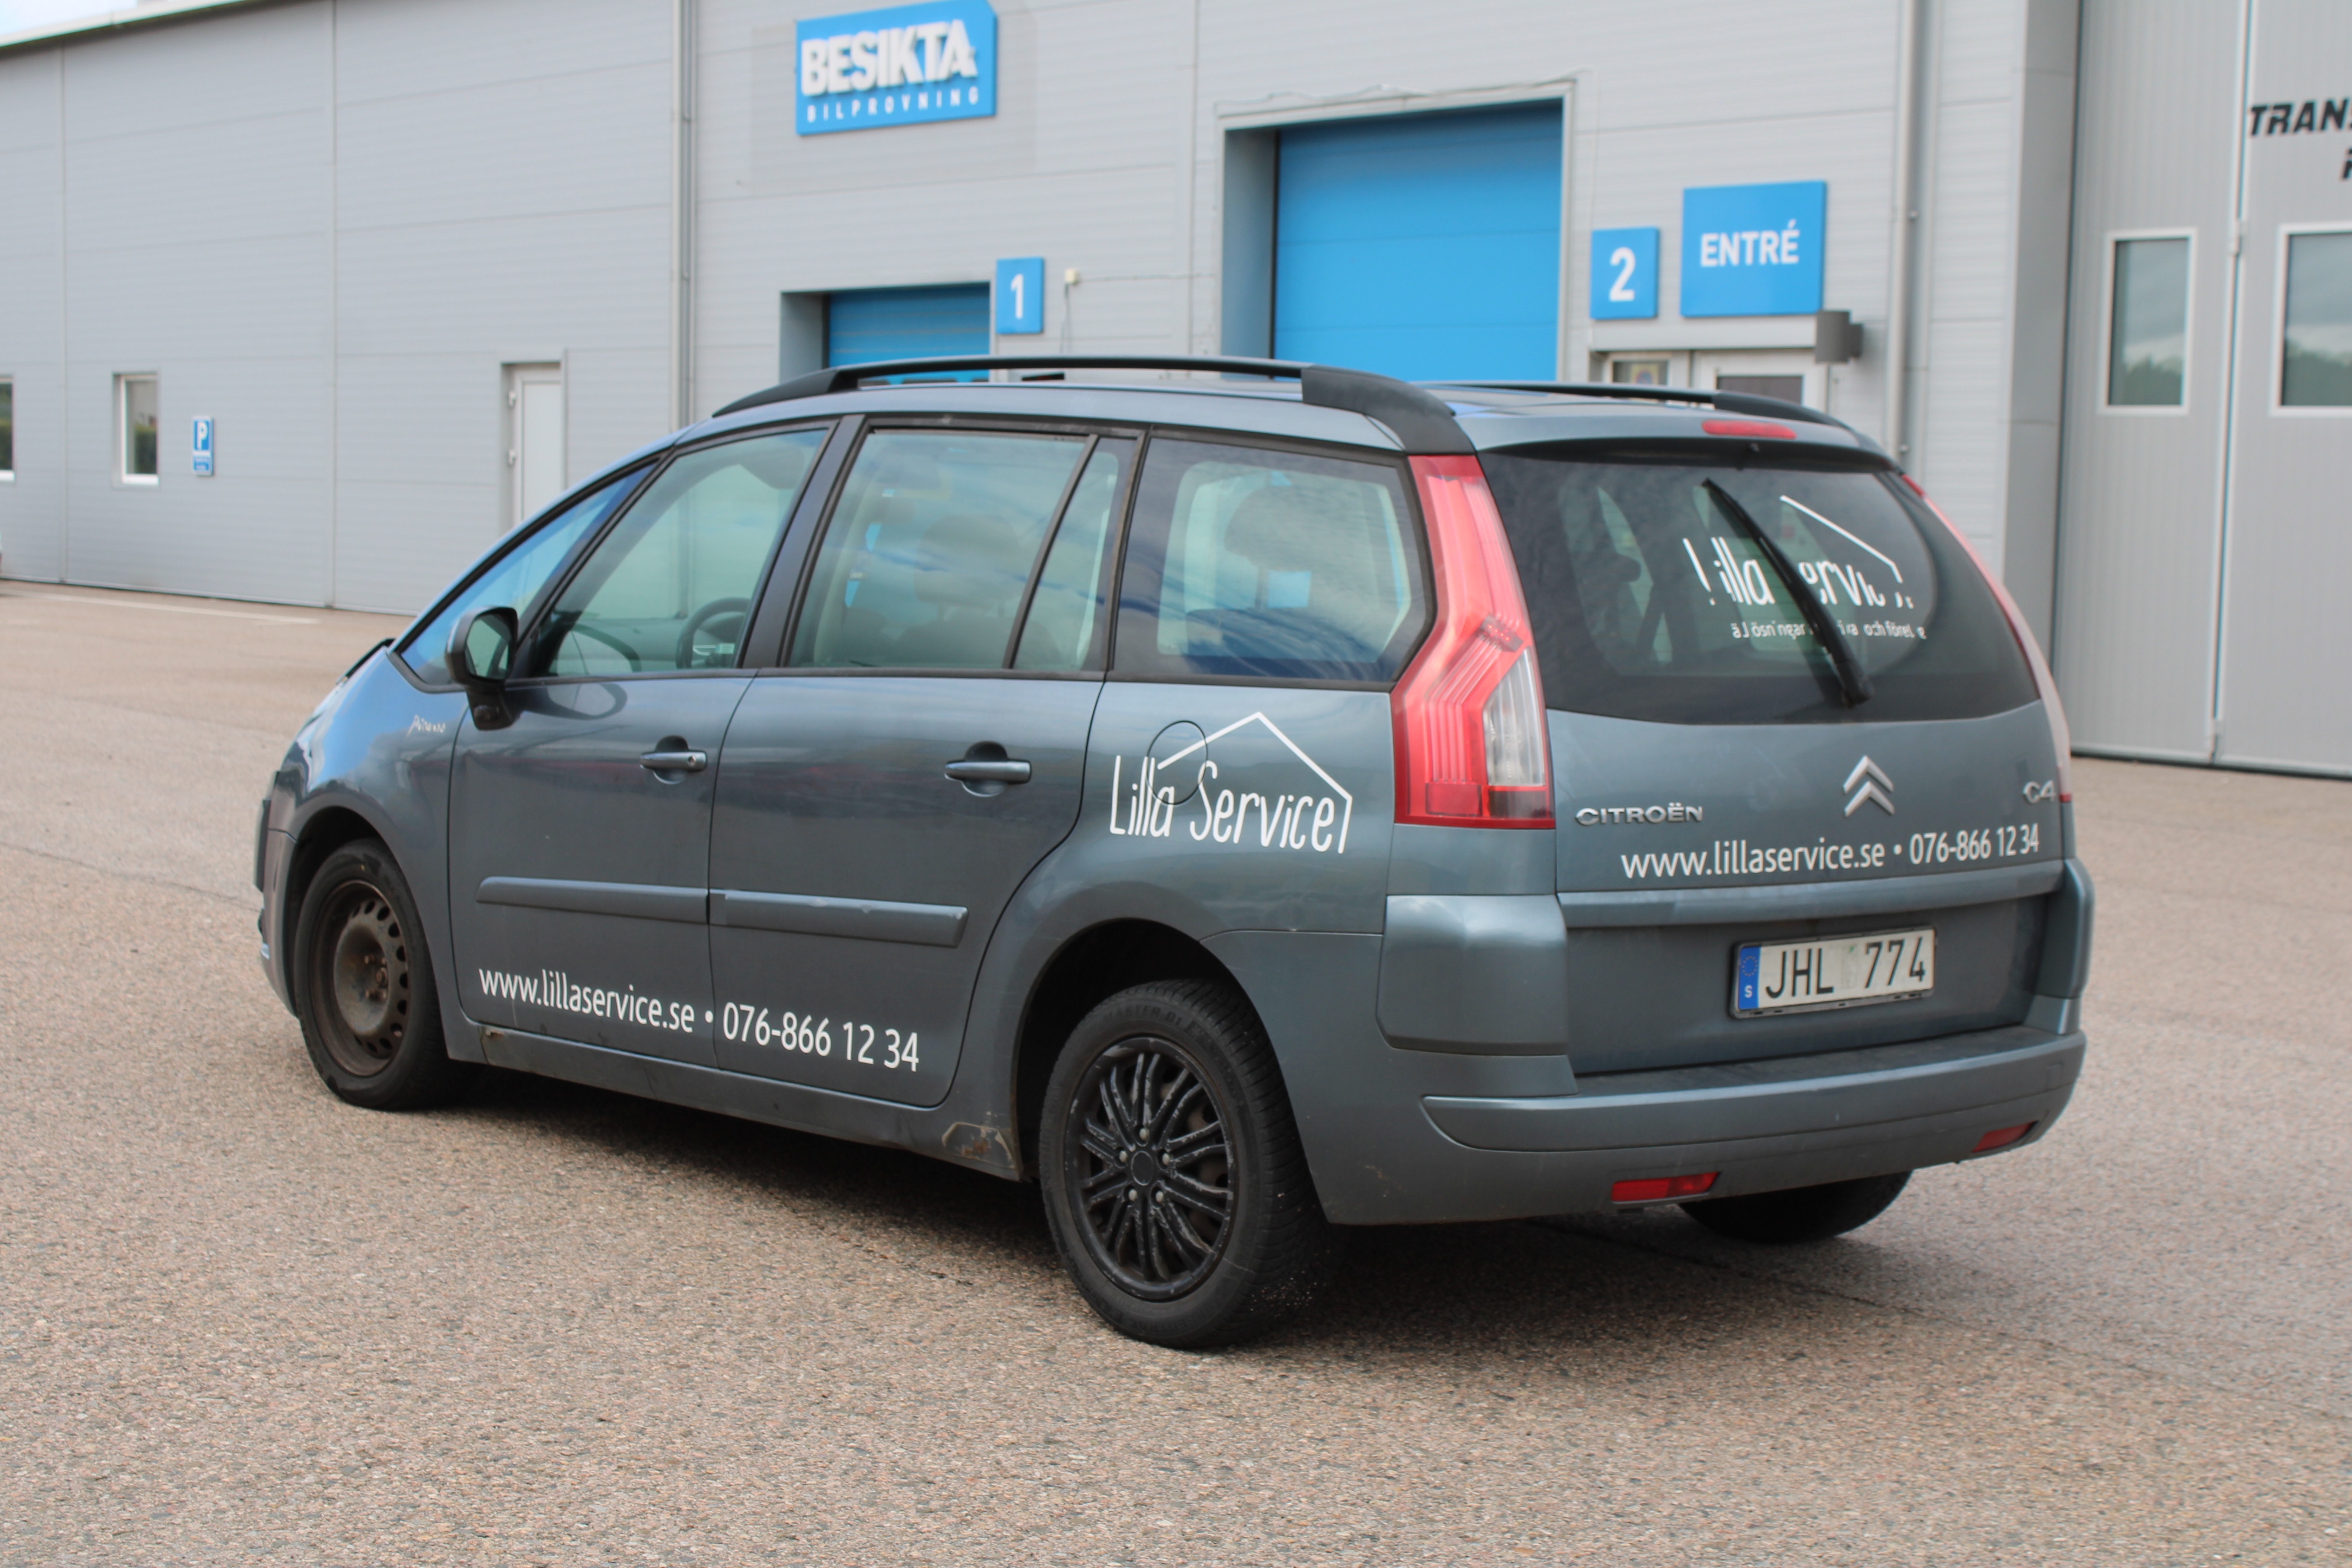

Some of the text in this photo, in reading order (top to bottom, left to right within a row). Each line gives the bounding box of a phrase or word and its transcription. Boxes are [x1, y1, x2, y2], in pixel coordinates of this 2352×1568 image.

[801, 18, 978, 97] BESIKTA
[806, 86, 979, 123] BILPROVNING
[2250, 97, 2352, 136] TRAN
[1700, 218, 1801, 267] ENTRÉ
[1010, 273, 1024, 319] 1
[1609, 246, 1636, 302] 2
[197, 422, 208, 449] P
[1109, 754, 1335, 852] Lilla Service
[1575, 802, 1703, 826] CITROËN
[2023, 780, 2056, 804] C4
[1620, 823, 2040, 878] www.lillaservice.se 076-866 12 34
[1765, 936, 1926, 999] JHL 774
[1744, 985, 1753, 998] S
[478, 968, 919, 1072] www.lillaservice.se 076-866 12 34
